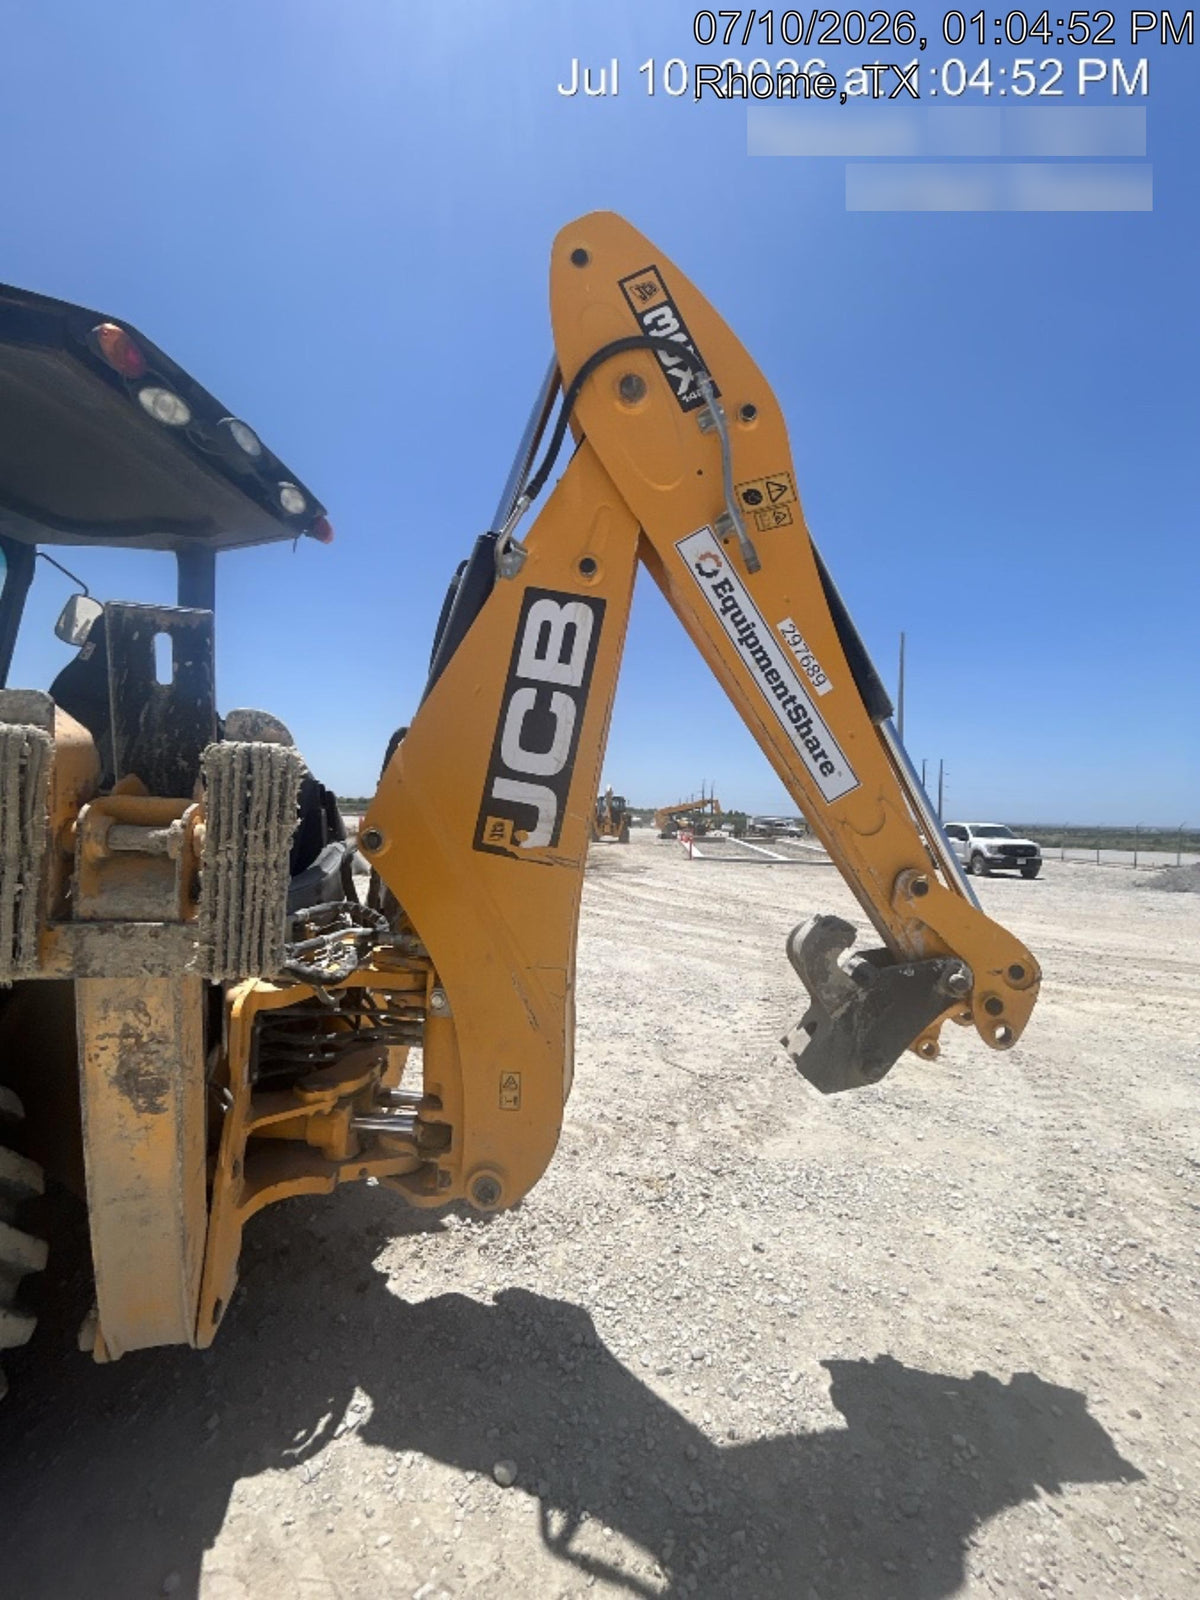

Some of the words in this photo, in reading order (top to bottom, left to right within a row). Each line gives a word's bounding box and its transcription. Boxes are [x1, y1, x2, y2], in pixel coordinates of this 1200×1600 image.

[491, 598, 595, 849] JCB
[711, 576, 836, 779] EquipmentShare
[780, 622, 827, 688] 297689
